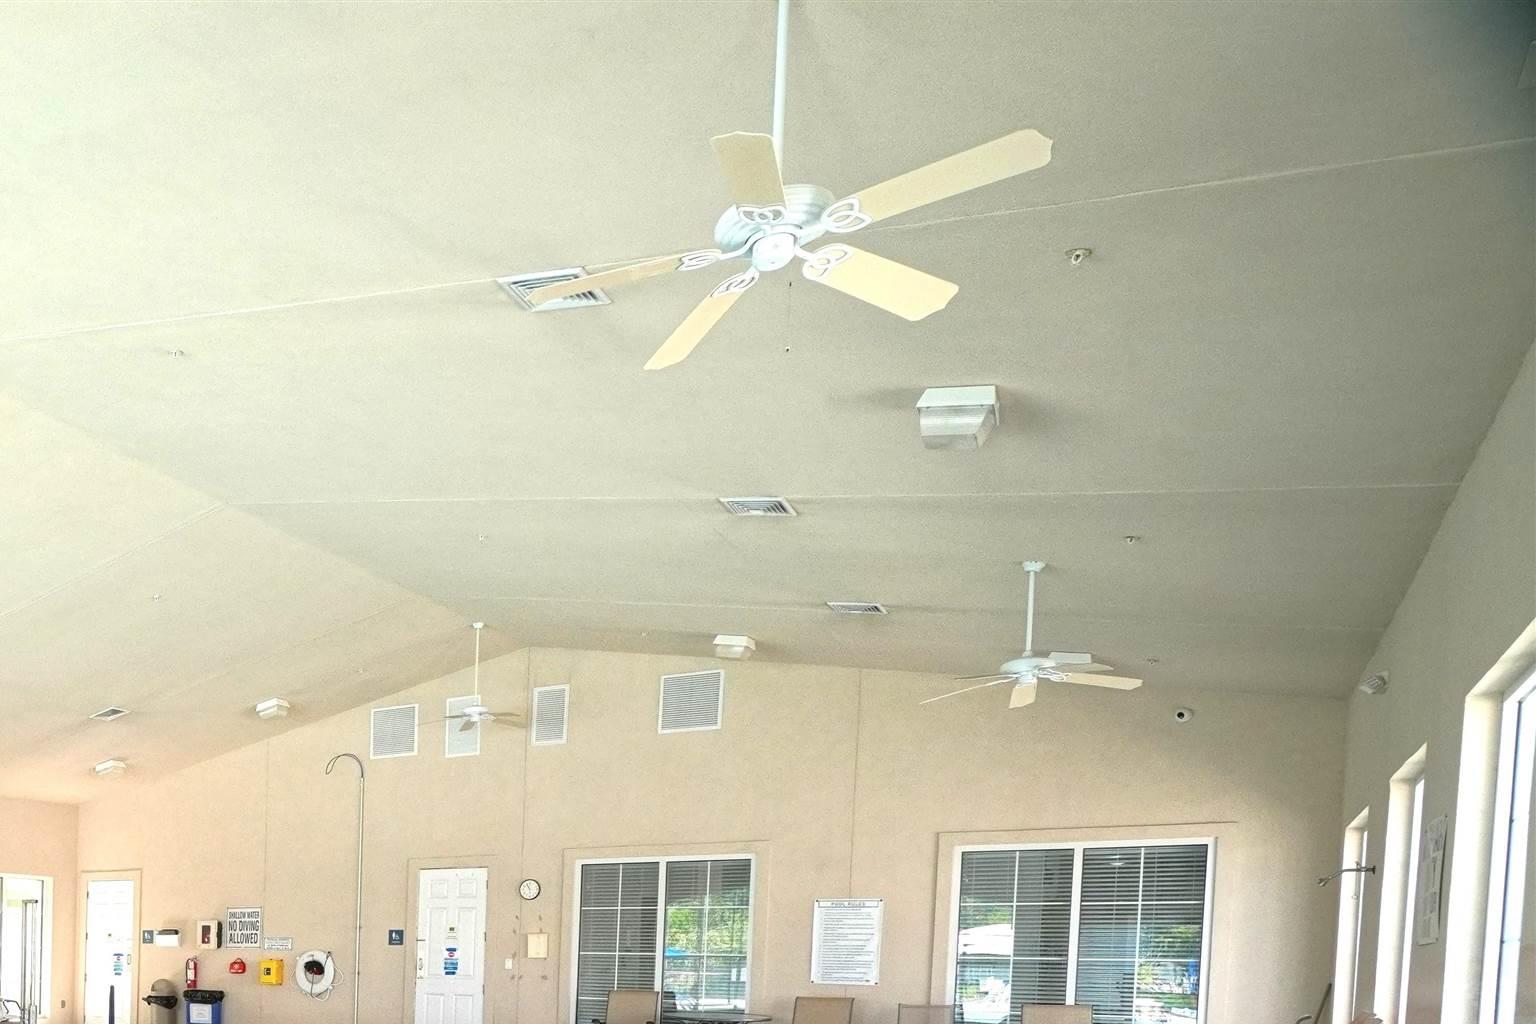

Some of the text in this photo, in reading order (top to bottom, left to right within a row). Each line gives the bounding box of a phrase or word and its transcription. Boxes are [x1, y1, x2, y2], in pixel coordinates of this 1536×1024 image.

[228, 911, 260, 920] SHALLOW WATER
[228, 920, 260, 932] NO DIVING
[228, 932, 259, 945] ALLOWED
